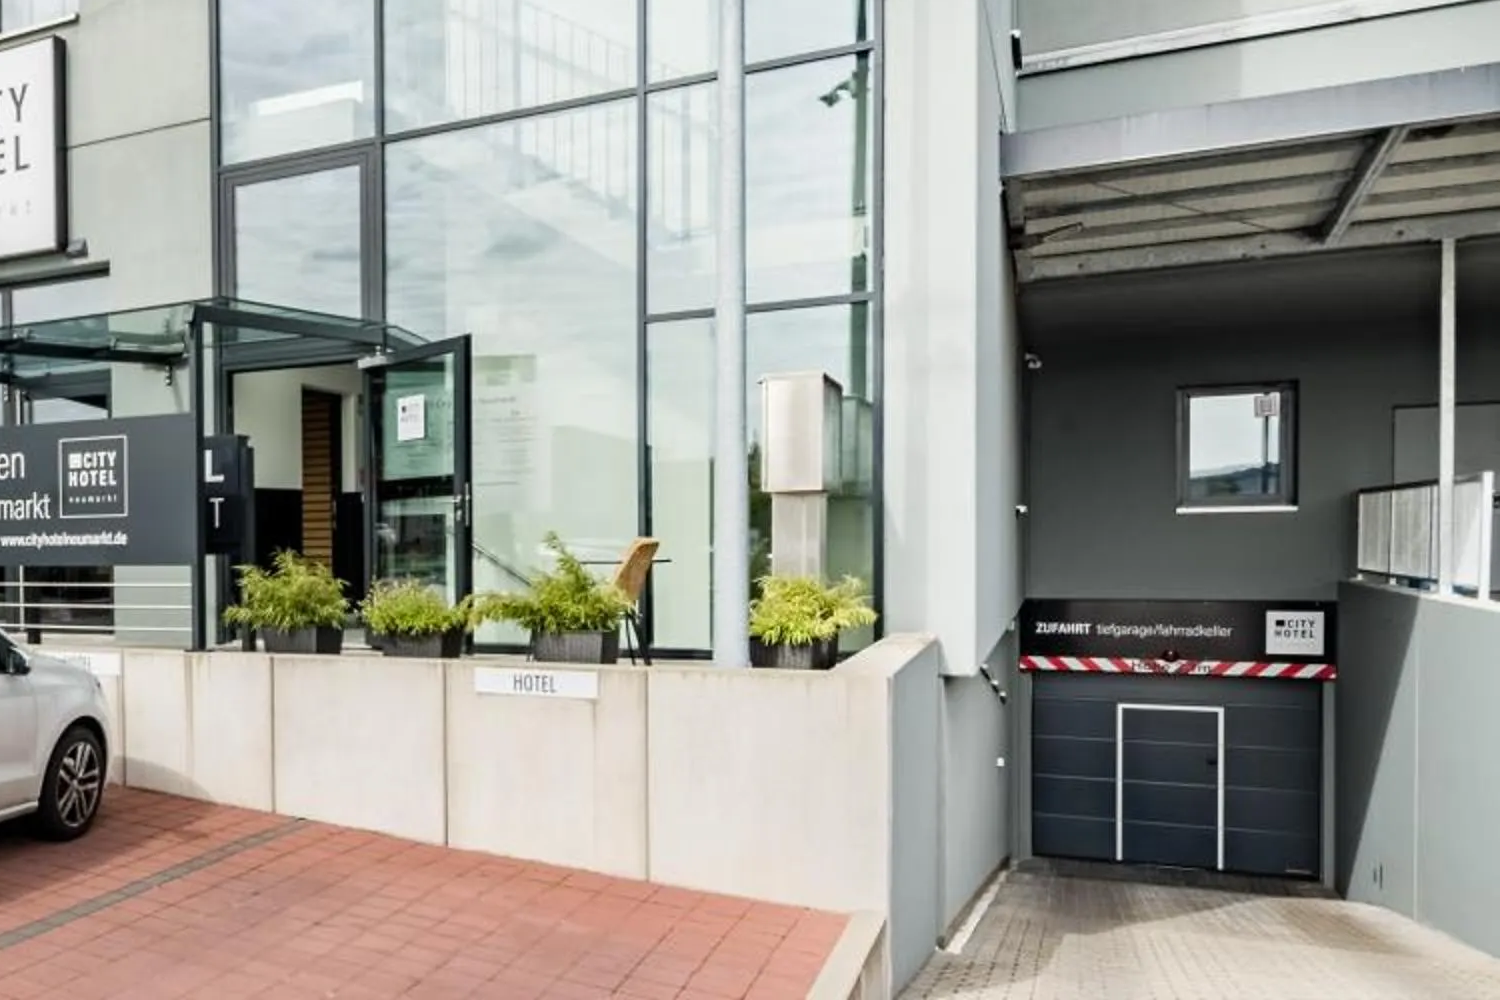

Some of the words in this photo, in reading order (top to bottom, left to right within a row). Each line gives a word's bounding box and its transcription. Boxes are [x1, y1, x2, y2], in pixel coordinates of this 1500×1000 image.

[83, 450, 117, 469] CITY
[204, 449, 225, 483] L
[68, 469, 117, 487] HOTEL
[209, 497, 225, 529] T
[1035, 621, 1092, 635] ZUFAHRT
[1287, 619, 1315, 629] CITY
[1274, 629, 1314, 639] HOTEL
[513, 674, 556, 693] HOTEL
